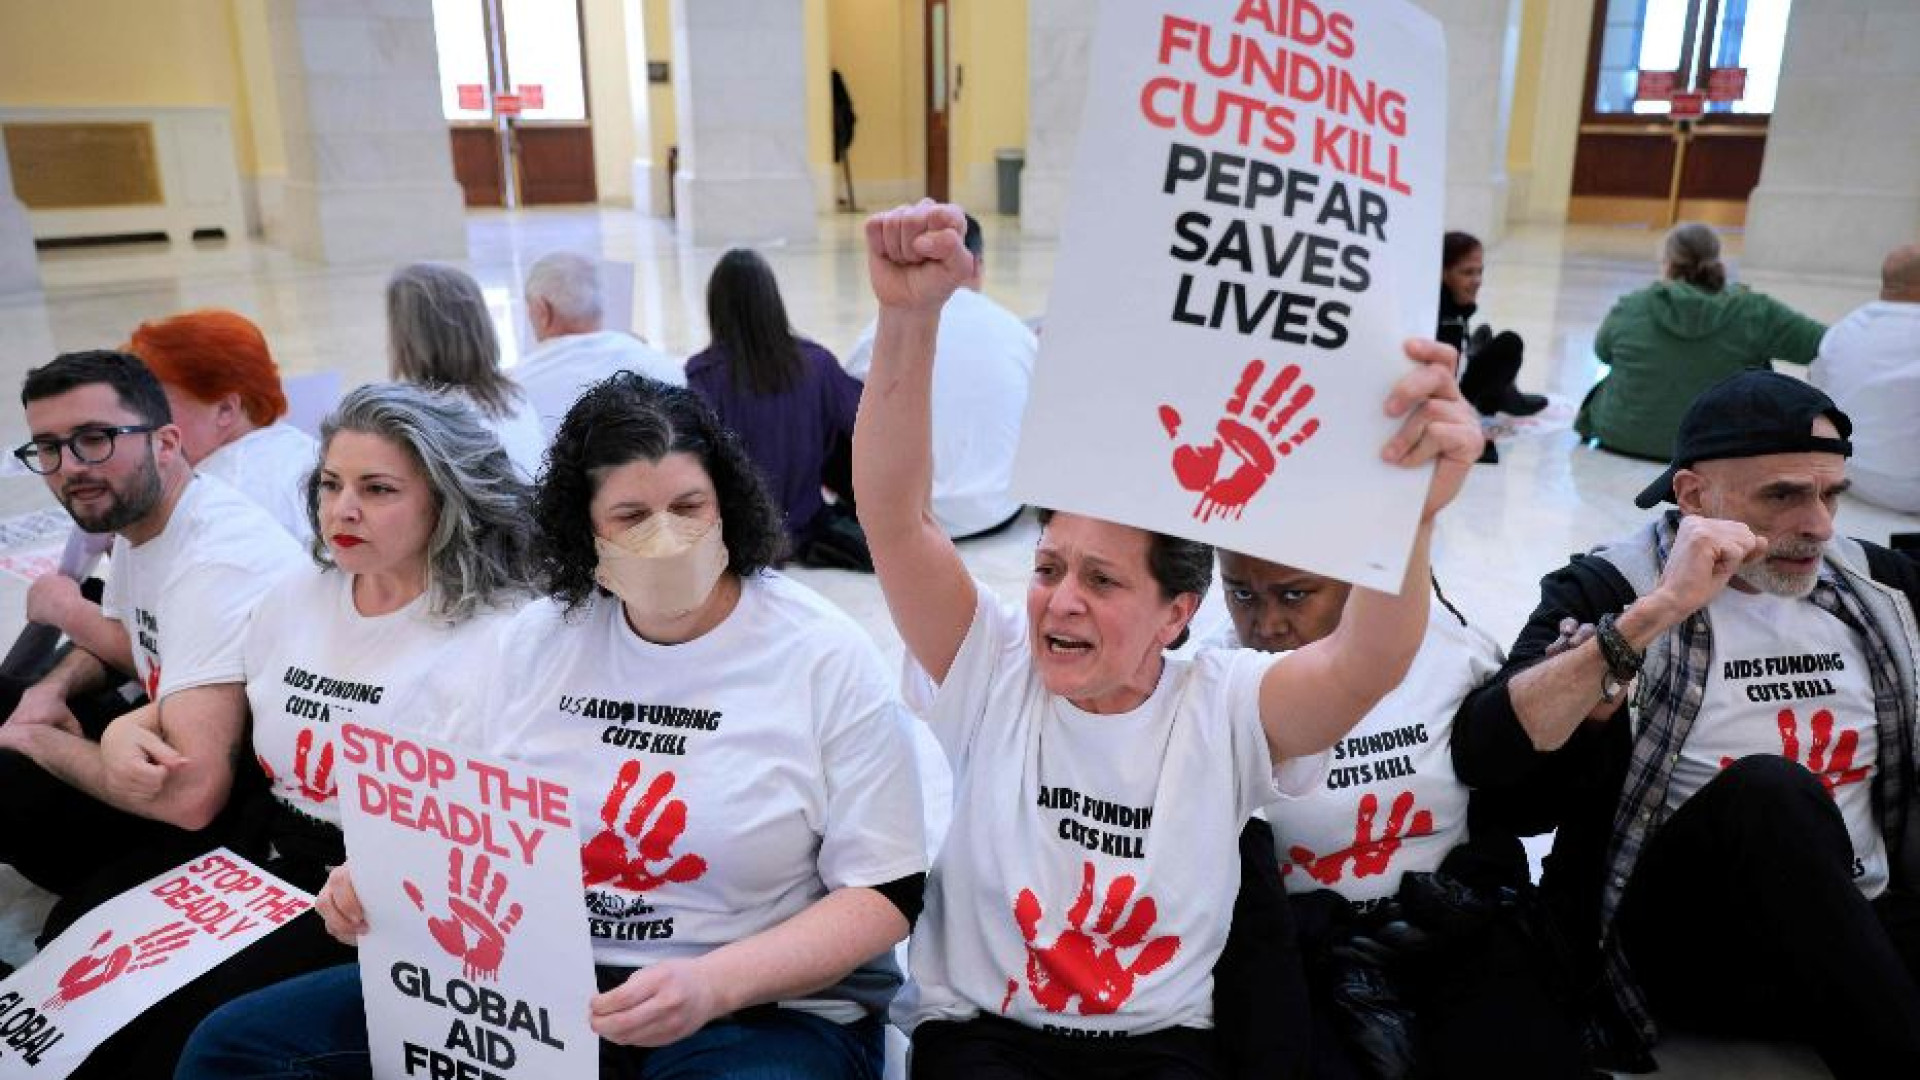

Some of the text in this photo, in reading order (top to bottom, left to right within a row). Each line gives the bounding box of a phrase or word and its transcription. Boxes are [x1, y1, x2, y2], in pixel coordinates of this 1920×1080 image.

[1234, 0, 1355, 59] AIDS
[1159, 15, 1407, 136] FUNDING
[1140, 77, 1411, 196] CUTS KILL
[1163, 143, 1388, 241] PEPFAR
[1170, 212, 1371, 292] SAVES
[1172, 275, 1351, 349] LIVES
[284, 666, 384, 704] AIDS FUNDING
[1724, 653, 1844, 679] AIDS FUNDING
[1747, 679, 1836, 701] CUTS KILL
[286, 695, 321, 719] CUTS
[638, 704, 722, 731] FUNDING
[602, 726, 687, 755] CUTS KILL
[1348, 724, 1428, 757] FUNDING
[341, 724, 570, 828] STOP THE
[1327, 755, 1416, 790] CUTS KILL
[357, 773, 545, 864] DEADLY
[1082, 796, 1153, 829] FUNDIN
[1101, 831, 1145, 858] KILL
[152, 876, 259, 940] DEADLY
[188, 856, 310, 924] STOP THE
[616, 917, 673, 940] LIVES
[391, 961, 564, 1051] GLOBAL
[445, 1018, 516, 1070] AID
